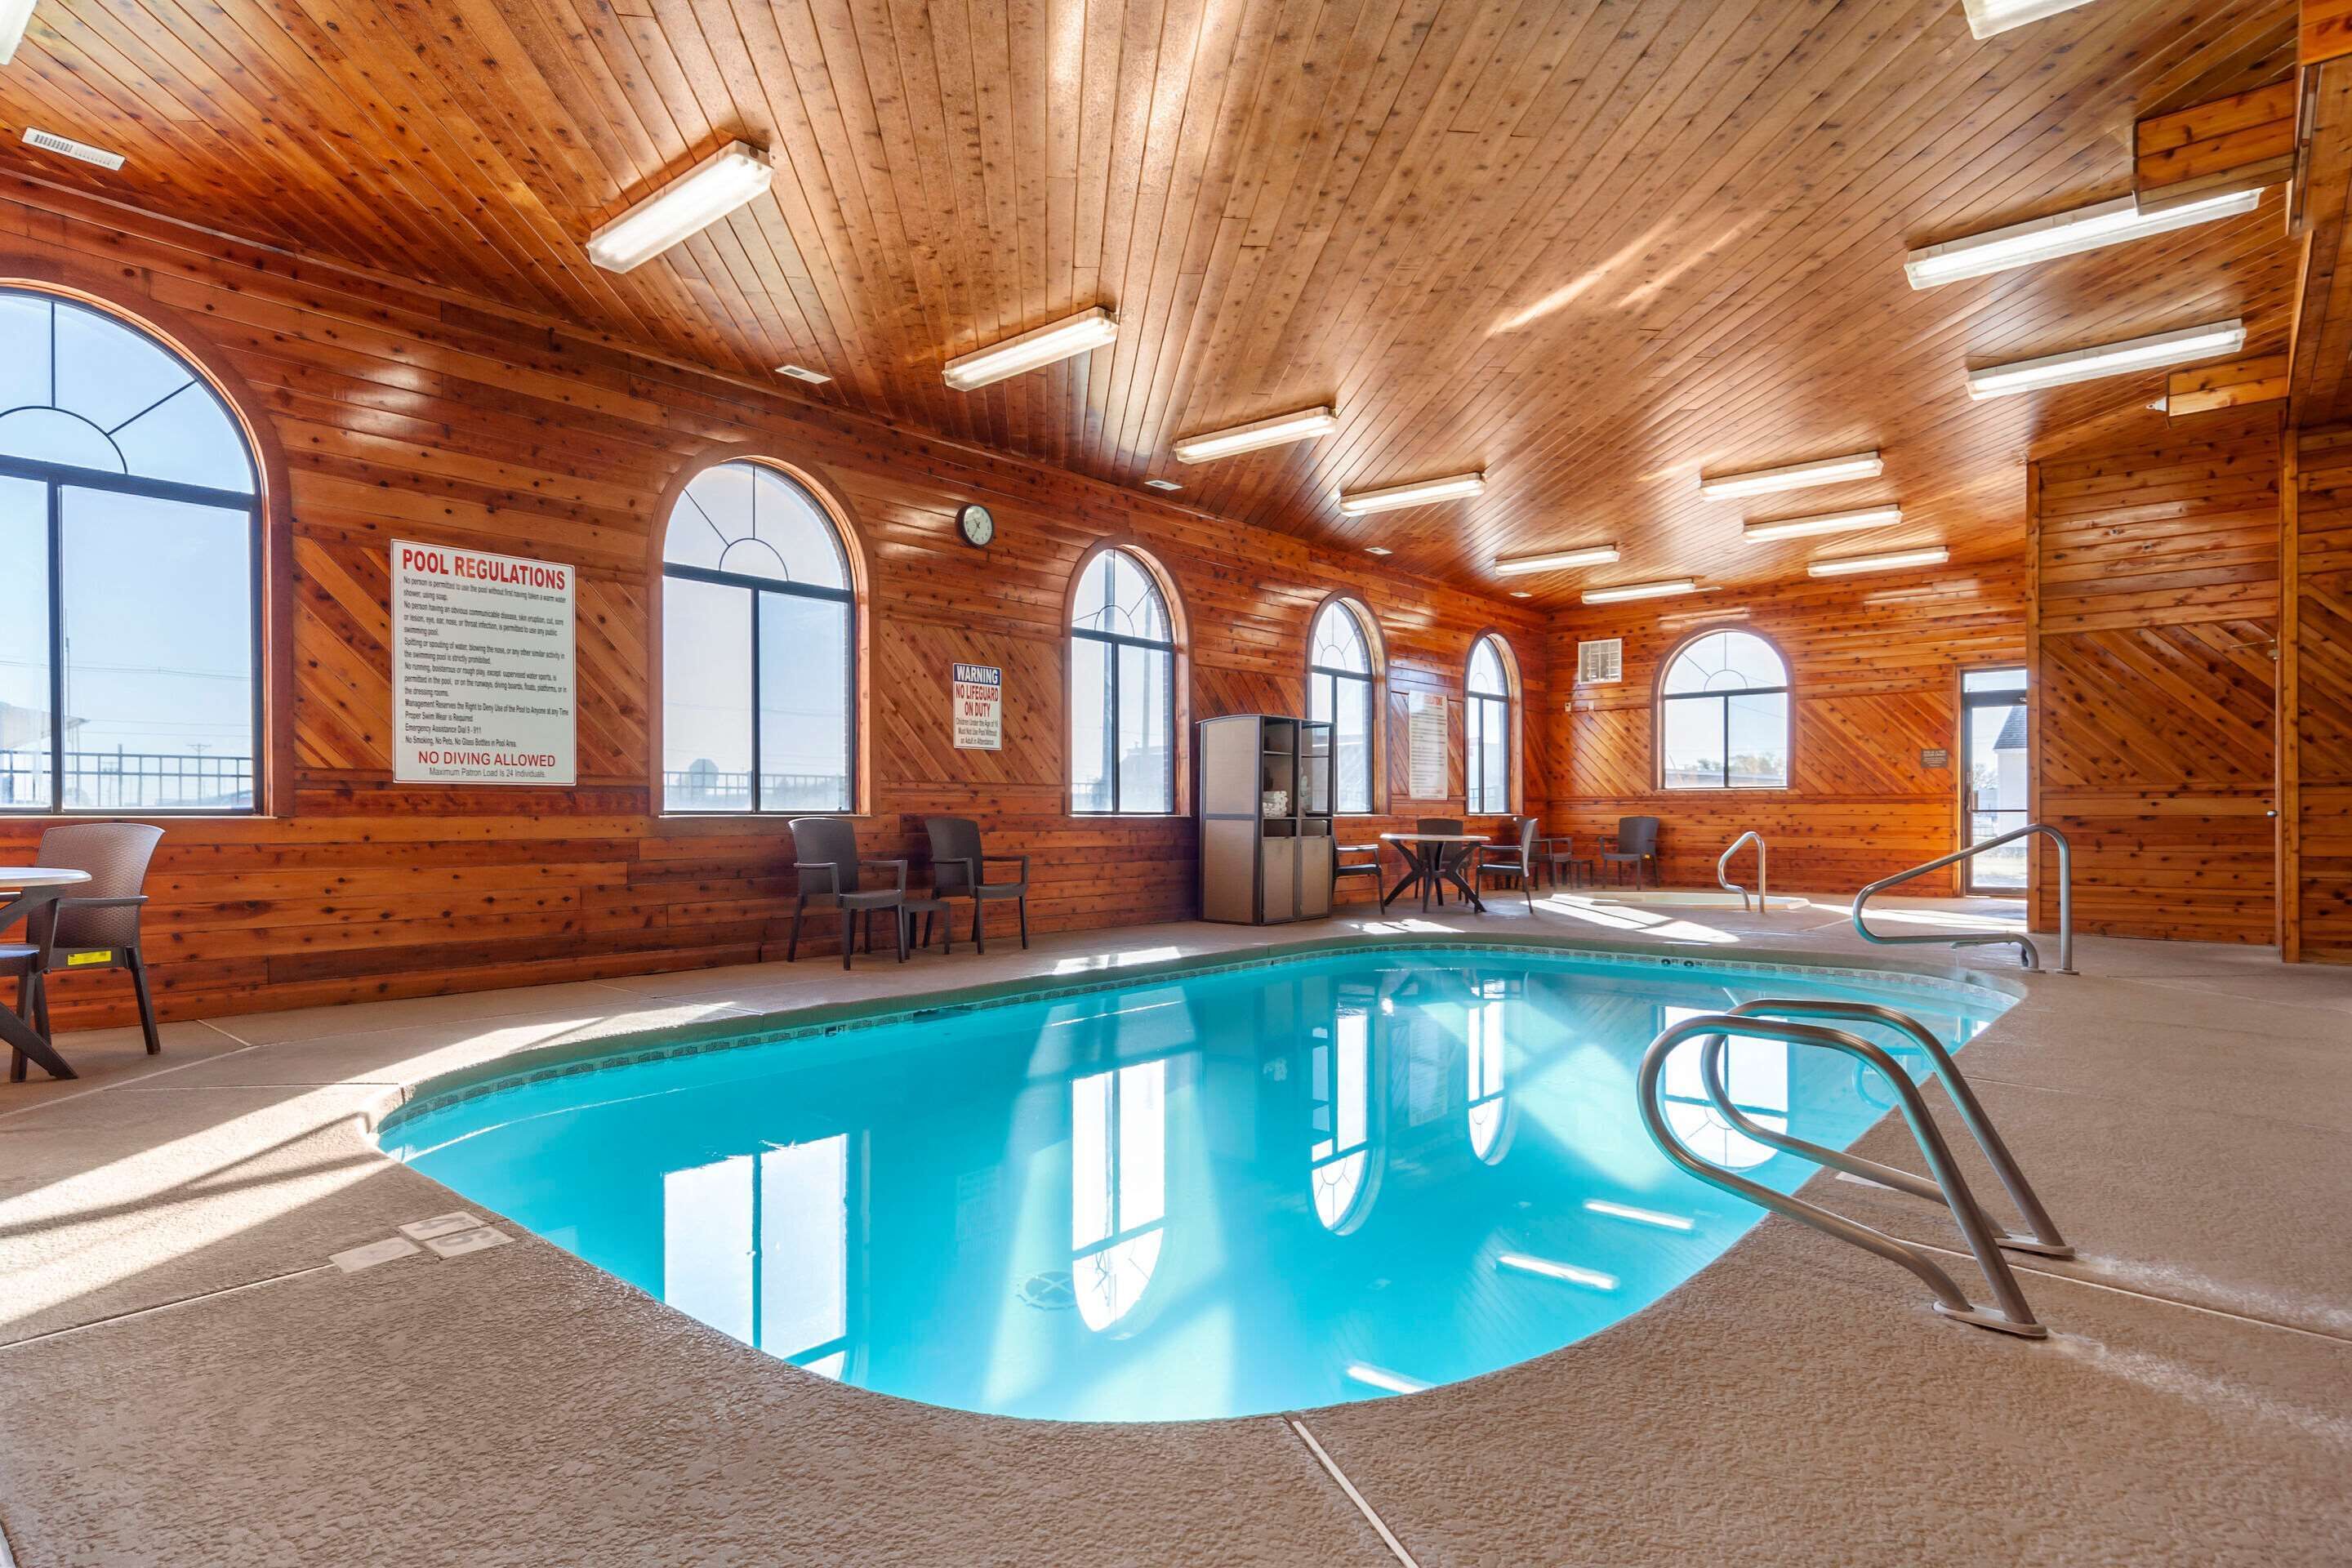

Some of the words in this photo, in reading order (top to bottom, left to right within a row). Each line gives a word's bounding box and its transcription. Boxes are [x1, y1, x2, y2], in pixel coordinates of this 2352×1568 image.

[403, 549, 449, 575] POOL
[455, 555, 565, 590] REGULATIONS
[404, 576, 410, 584] No
[412, 578, 427, 586] person
[432, 581, 455, 590] permitted
[412, 603, 427, 611] person
[429, 604, 443, 614] having
[452, 655, 466, 664] strictly
[956, 665, 998, 684] WARNING
[956, 684, 964, 699] NO
[967, 685, 999, 702] LIFEGUARD
[405, 698, 434, 709] Management
[436, 700, 456, 709] Reserves
[465, 702, 477, 711] Right
[483, 703, 493, 713] Deny
[495, 704, 503, 712] Use
[516, 705, 525, 713] Pool
[531, 706, 546, 715] Anyone
[559, 707, 568, 715] Time
[964, 701, 973, 716] ON
[975, 702, 991, 718] DUTY
[405, 710, 421, 720] Proper
[405, 723, 431, 733] Emergency
[433, 725, 457, 733] Assistance
[457, 725, 466, 733] Dial
[405, 735, 412, 744] No
[435, 737, 441, 745] No
[475, 737, 490, 746] Bottles
[496, 738, 505, 746] Pool
[419, 751, 439, 764] NO
[444, 751, 491, 765] DIVING
[494, 753, 555, 767] ALLOWED
[430, 767, 460, 776] Maximum
[461, 768, 482, 777] Patron
[483, 768, 498, 777] Load
[506, 769, 514, 777] 24
[412, 1216, 466, 1232] 4
